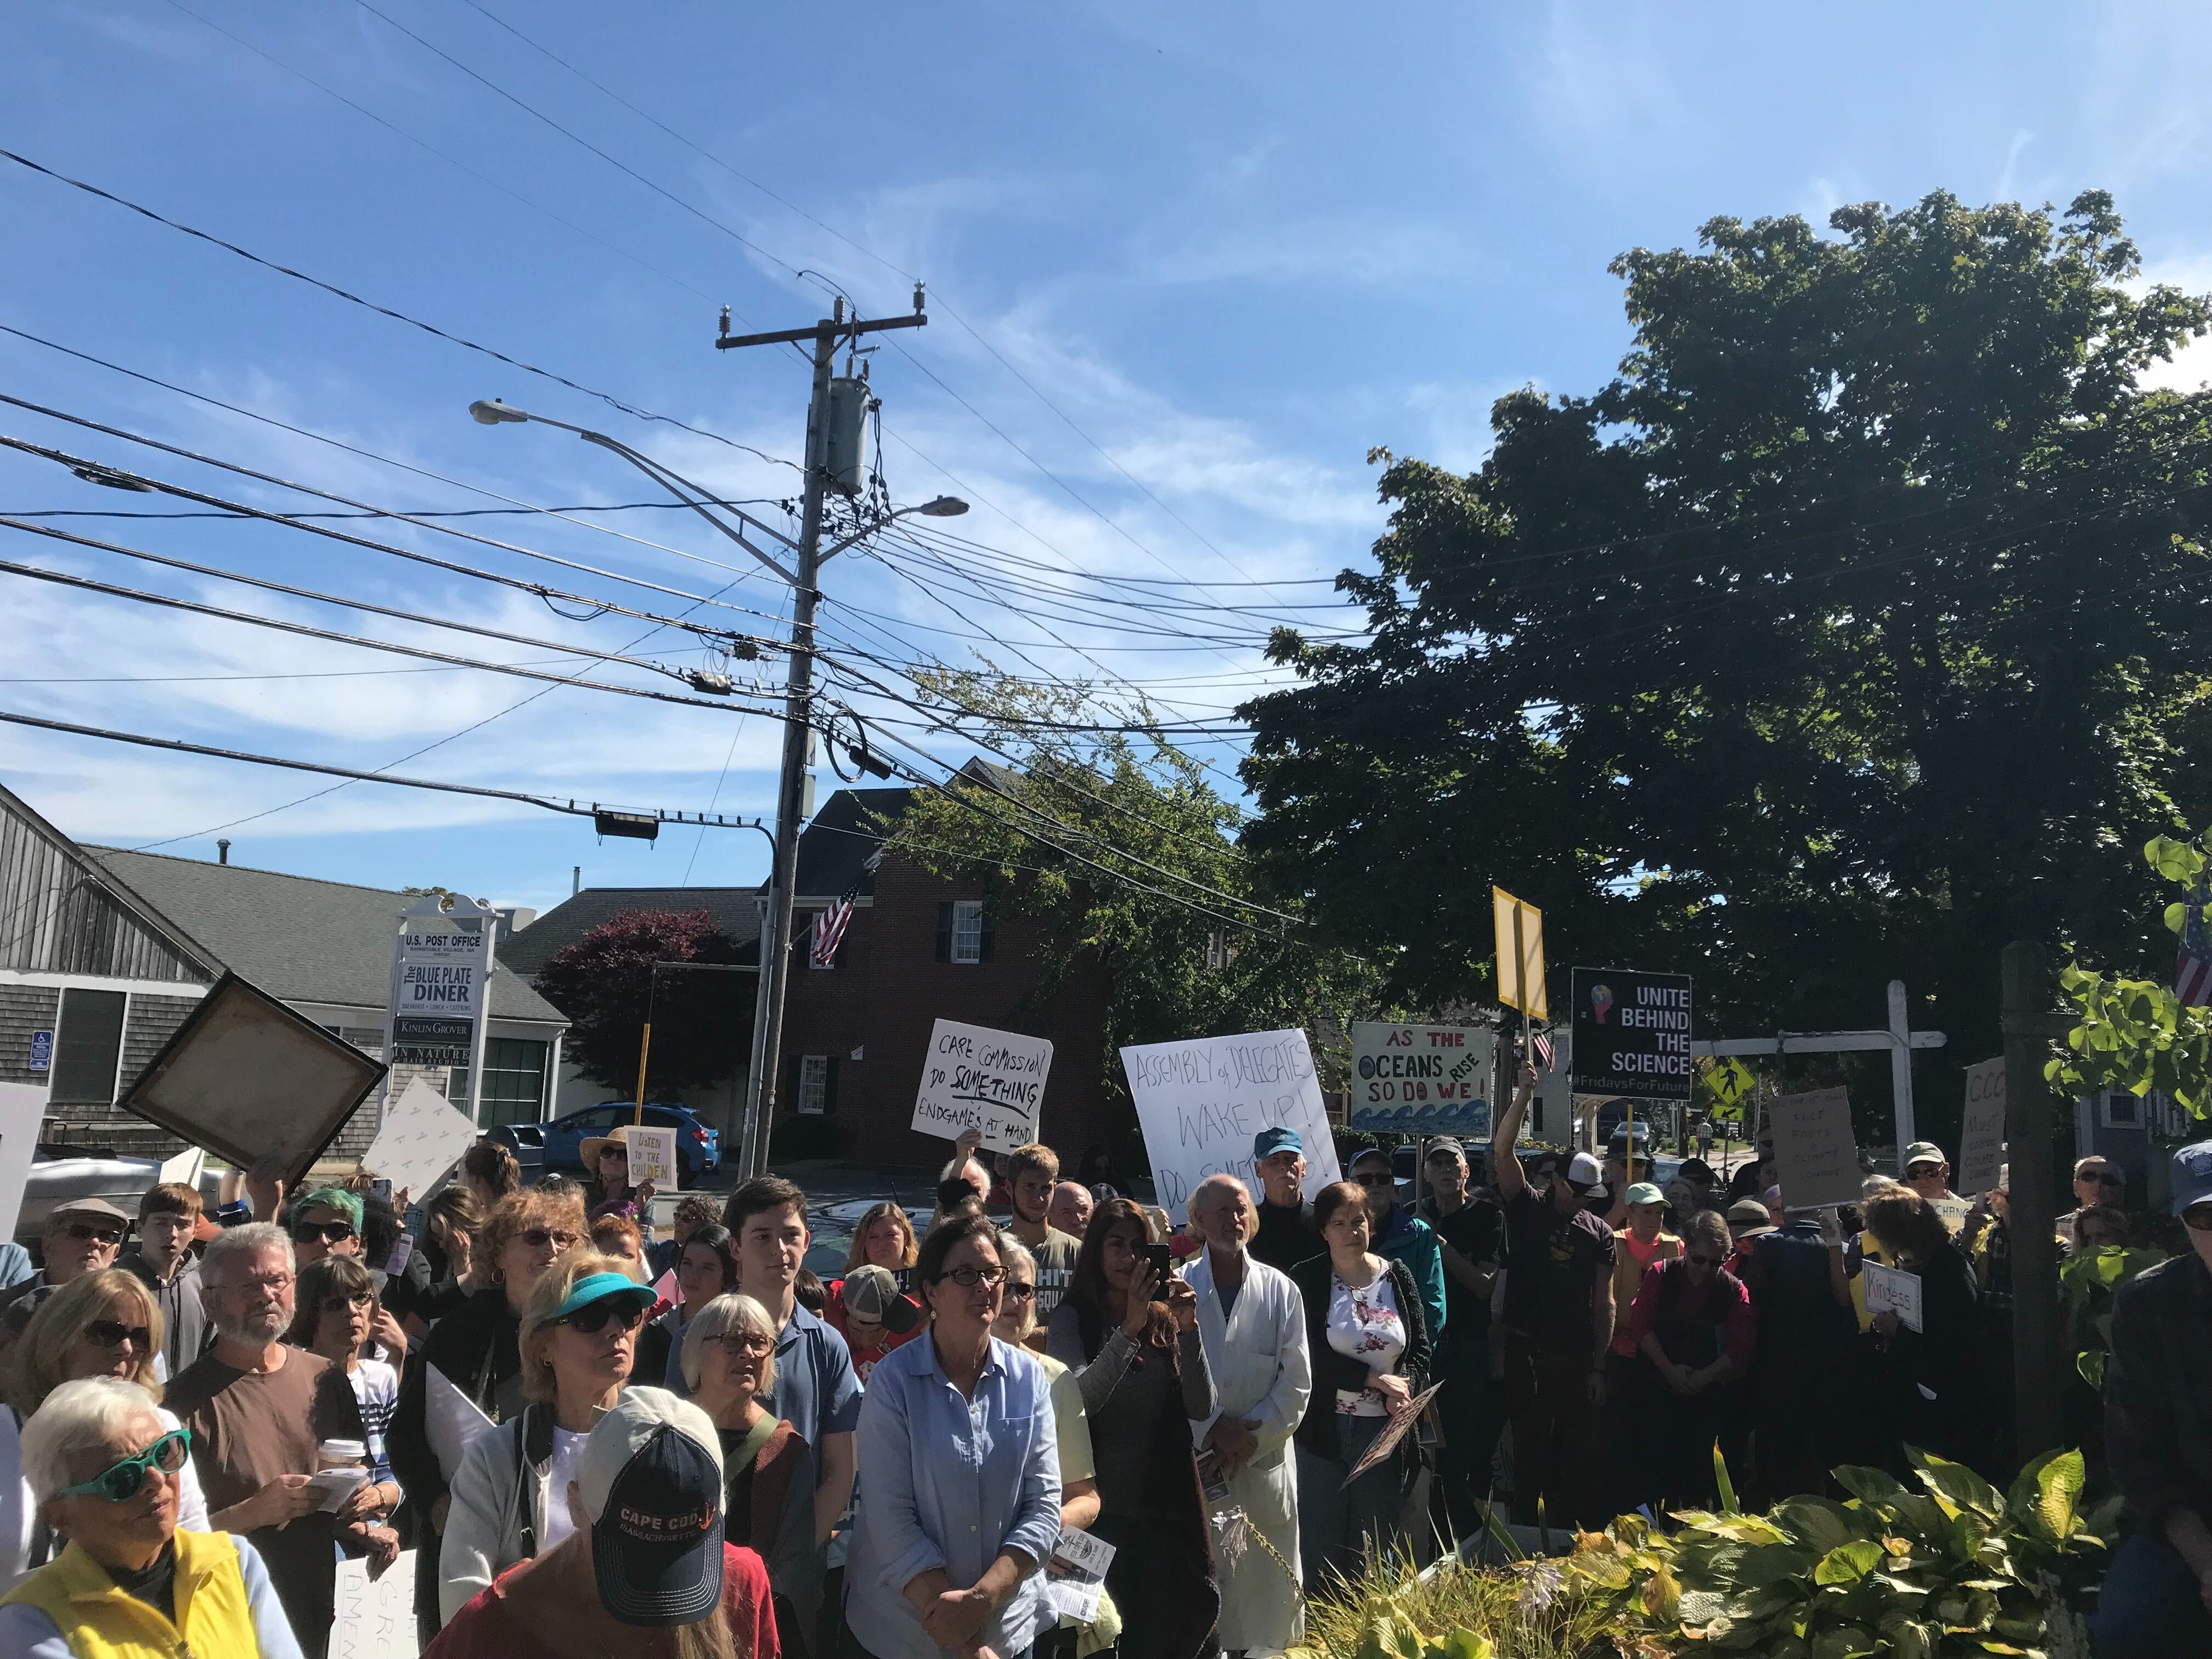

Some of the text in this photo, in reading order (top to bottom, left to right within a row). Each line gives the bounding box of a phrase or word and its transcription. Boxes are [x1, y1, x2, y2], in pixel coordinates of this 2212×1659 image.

[406, 935, 481, 947] U.S. POST OFFICE
[404, 966, 472, 984] The BLUE PLATE
[414, 984, 469, 1002] DINER
[1637, 987, 1689, 1008] UNITE
[1621, 1008, 1689, 1030] BEHIND
[939, 1035, 973, 1058] CAPE
[1386, 1030, 1465, 1047] AS THE
[1656, 1032, 1689, 1053] THE
[395, 1047, 469, 1060] IN NATURE
[1137, 1047, 1212, 1088] ASSEMBLY
[1226, 1037, 1313, 1088] DELEGATES
[1612, 1052, 1690, 1075] SCIENCE
[1358, 1052, 1480, 1082] OCEANS RISE
[930, 1065, 1039, 1112] DO SOMETHING
[1368, 1082, 1395, 1102] SO
[1403, 1081, 1427, 1101] DO
[985, 1118, 1003, 1131] AT
[1005, 1124, 1031, 1144] HAND
[1177, 1103, 1251, 1149] WAKE
[647, 1152, 660, 1163] THE
[1161, 1169, 1187, 1210] DO
[1038, 1290, 1064, 1313] SQU
[621, 1509, 698, 1530] CAPE COD
[376, 1581, 398, 1659] GRE
